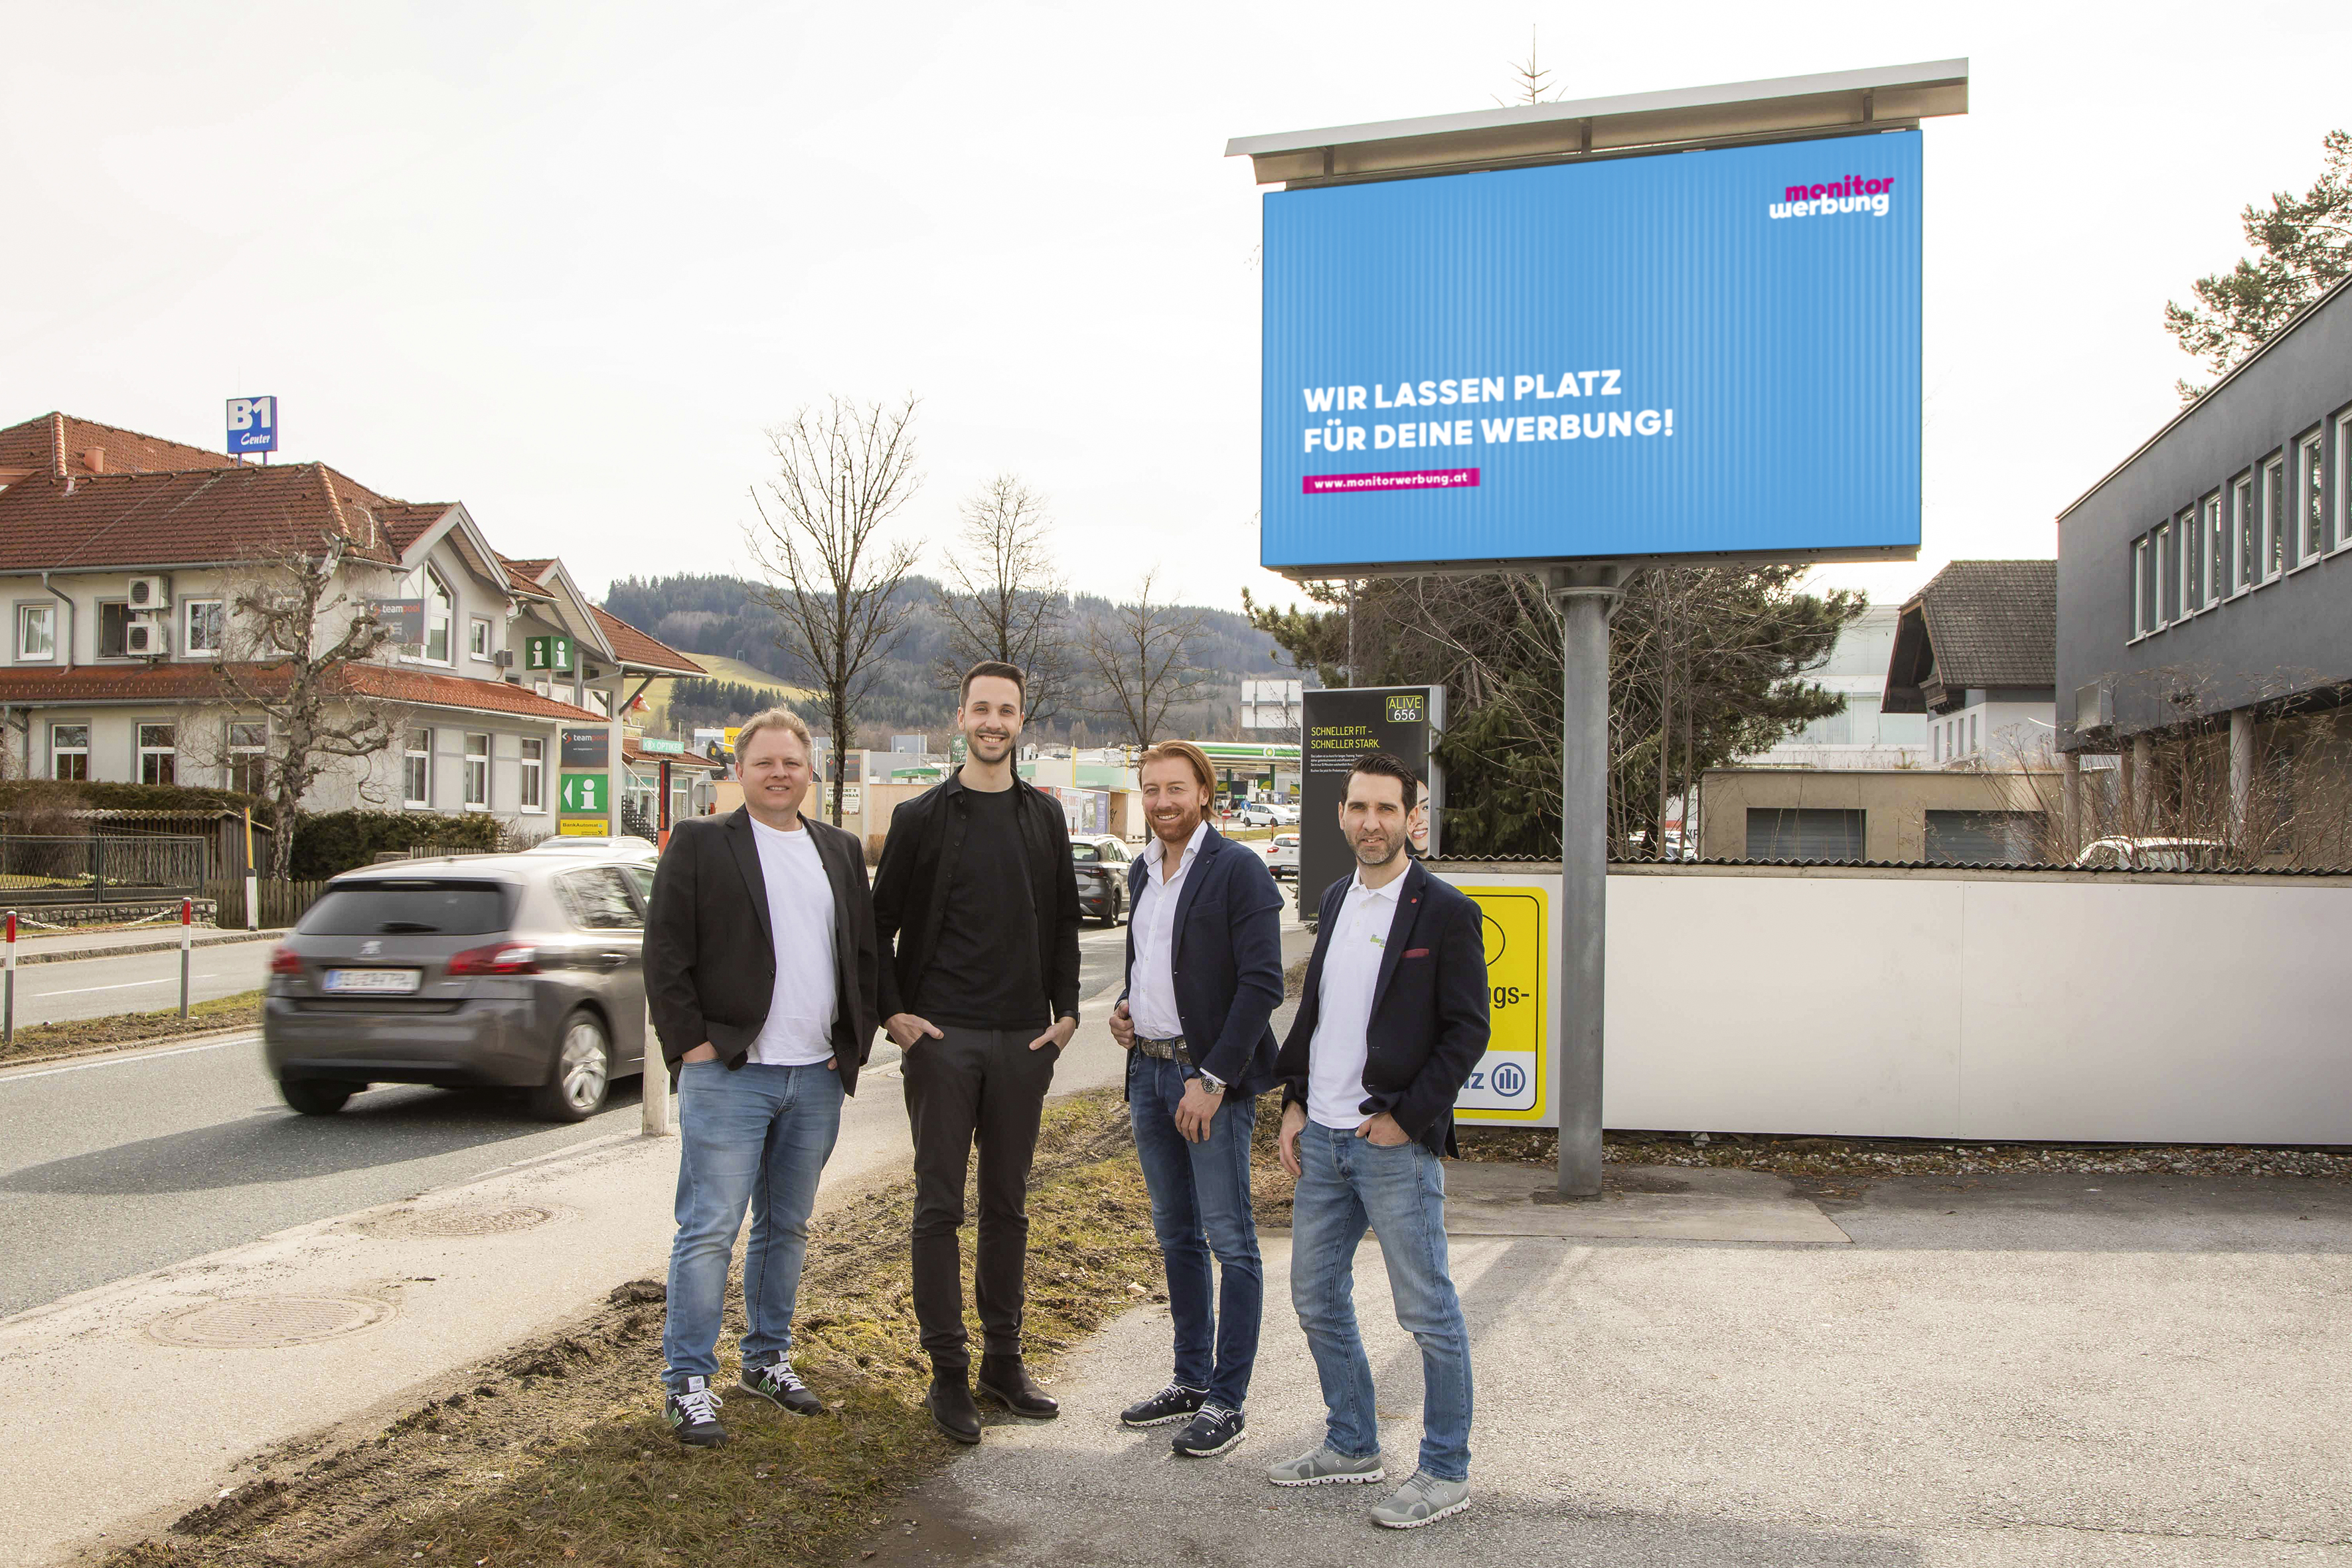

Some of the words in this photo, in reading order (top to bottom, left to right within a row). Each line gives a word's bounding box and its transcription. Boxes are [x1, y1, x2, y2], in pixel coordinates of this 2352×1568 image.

[1785, 175, 1895, 202] monitor
[1769, 193, 1889, 219] werbung
[1303, 385, 1367, 412] WIR
[1375, 376, 1504, 409] LASSEN
[1514, 369, 1621, 400] PLATZ
[228, 397, 271, 431] B1
[241, 432, 270, 445] Center
[1304, 418, 1366, 453] FÜR
[1374, 420, 1473, 450] DEINE
[1480, 409, 1674, 443] WERBUNG!
[1314, 471, 1468, 490] www.monitorwerbung.at
[1389, 697, 1421, 709] ALIVE
[1393, 709, 1416, 721] 656
[1310, 726, 1354, 736] SCHNELLER
[1355, 726, 1367, 736] FIT
[657, 742, 682, 751] OPTIKER
[1310, 739, 1354, 749] SCHNELLER
[1355, 739, 1380, 748] STARK.
